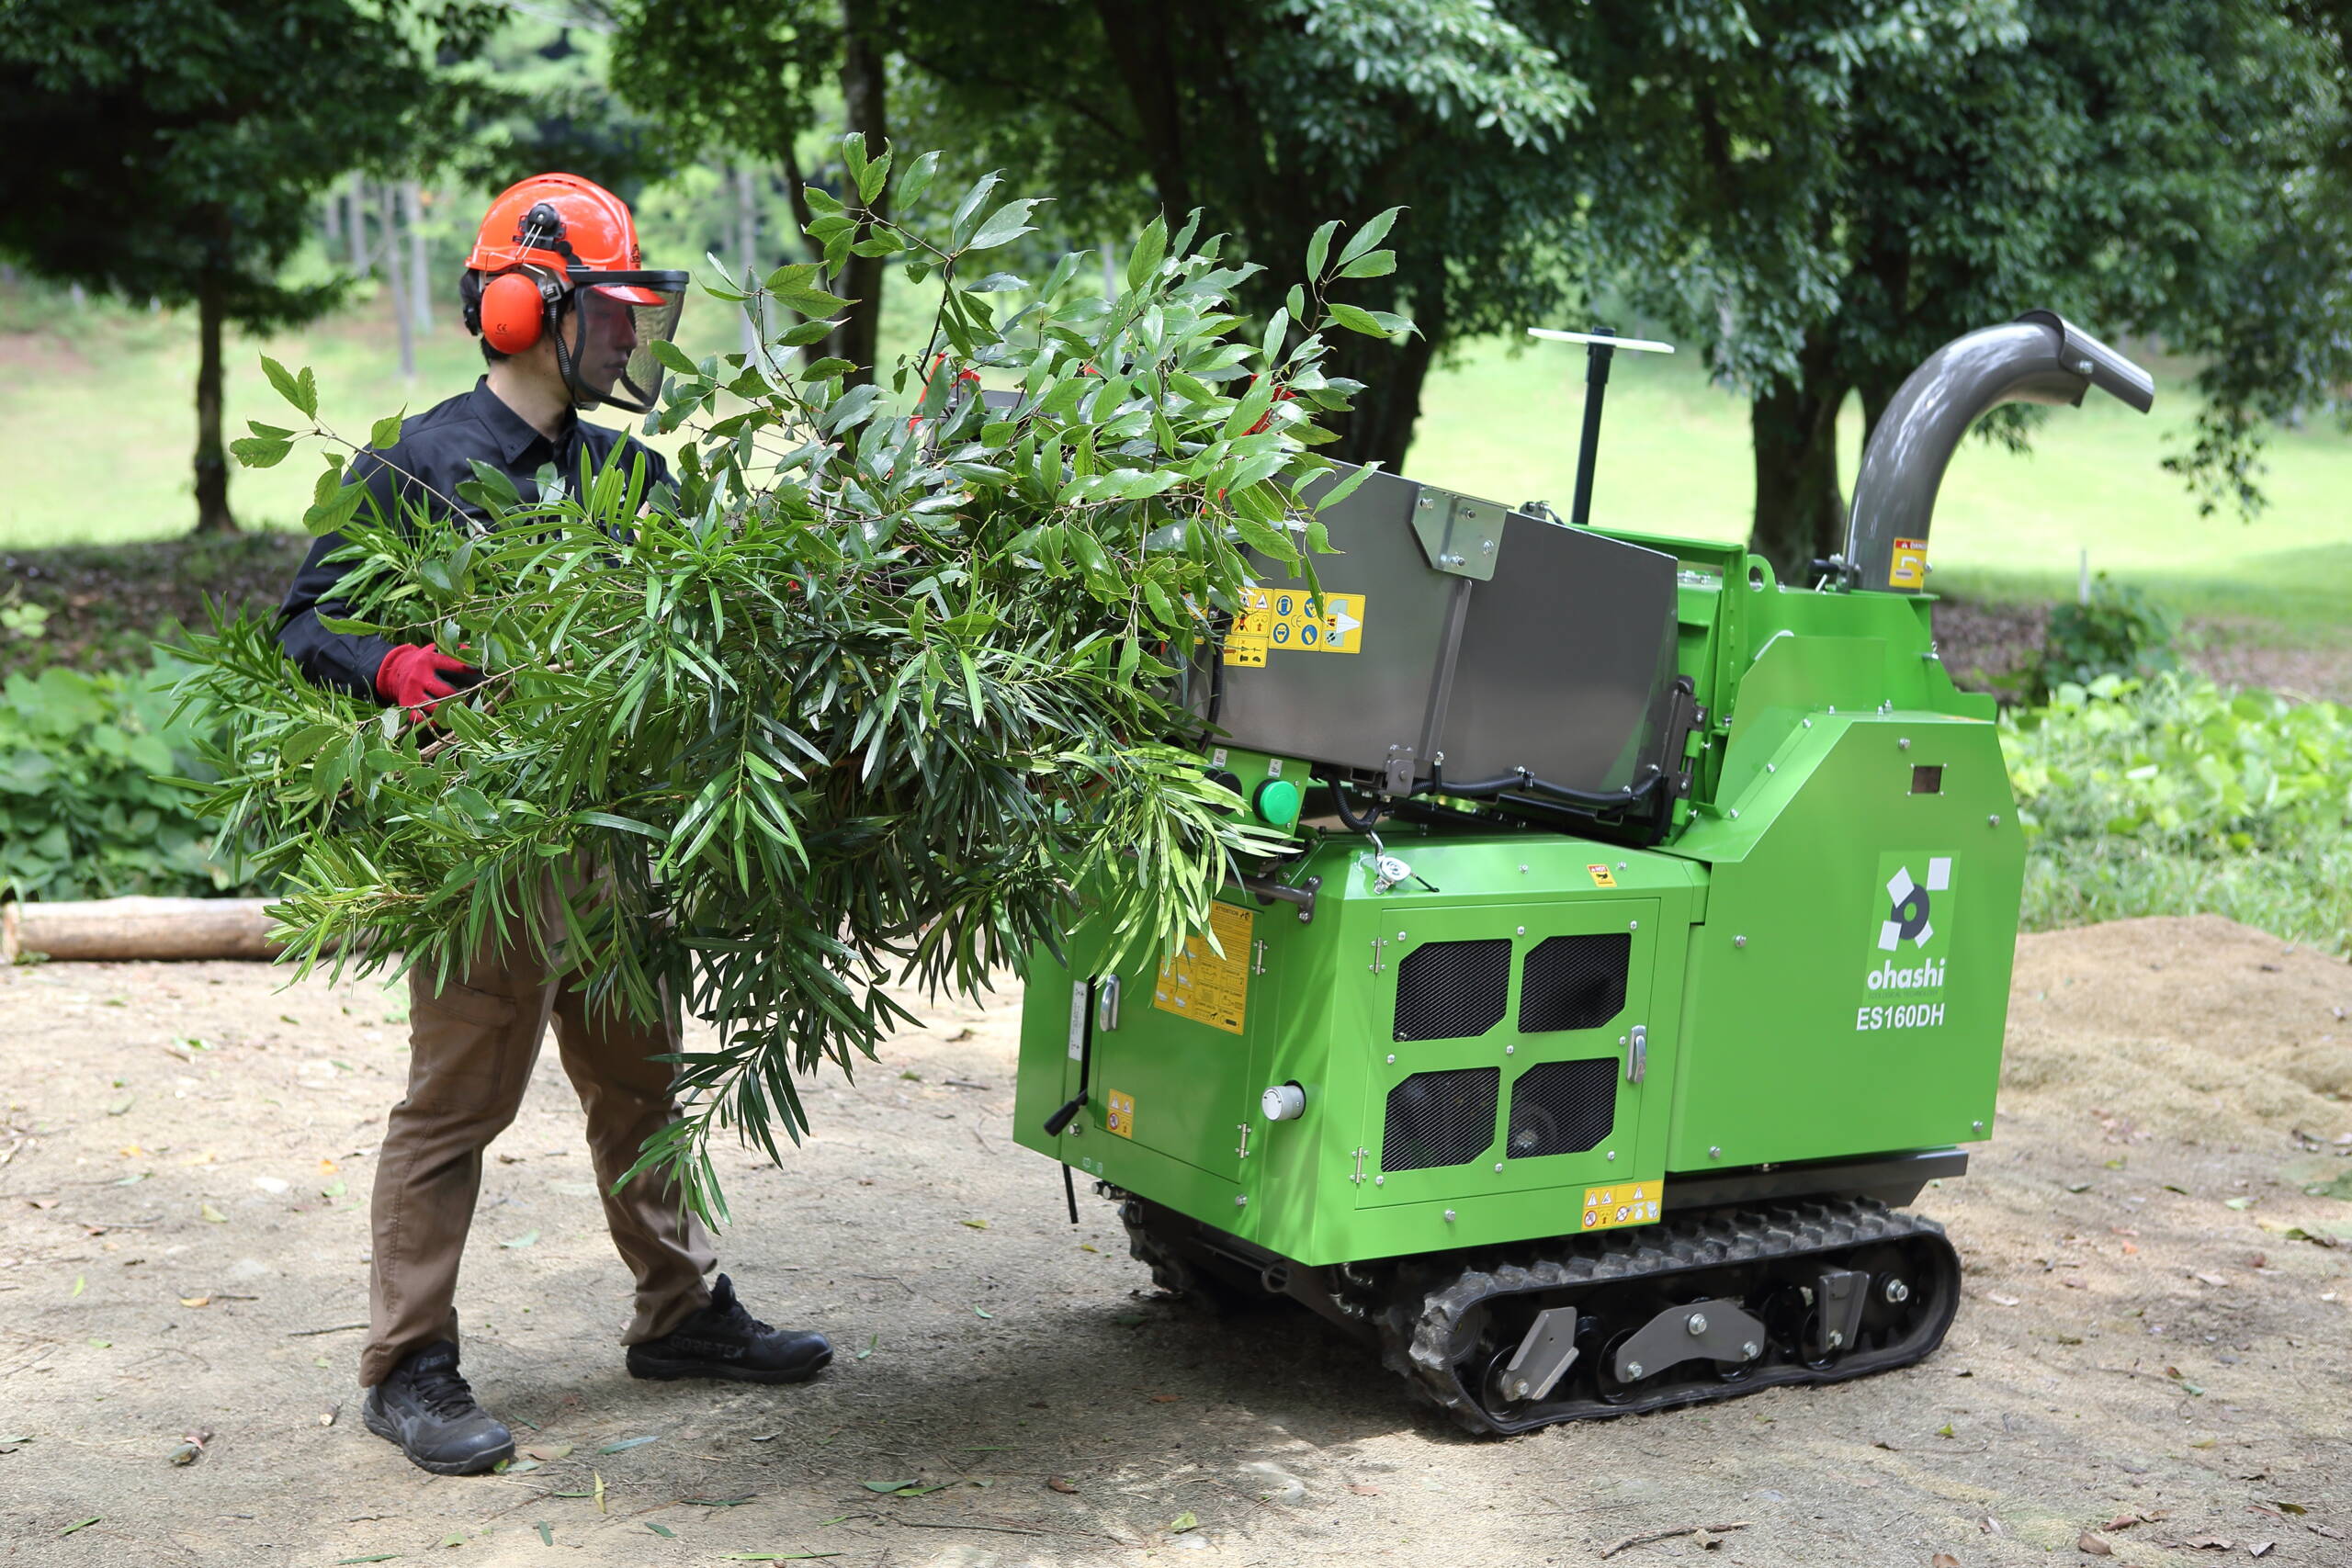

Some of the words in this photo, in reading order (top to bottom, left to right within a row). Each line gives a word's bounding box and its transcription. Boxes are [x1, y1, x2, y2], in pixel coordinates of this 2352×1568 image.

[1290, 615, 1302, 628] CE
[1868, 958, 1946, 990] ohashi
[1856, 1003, 1945, 1031] ES160DH
